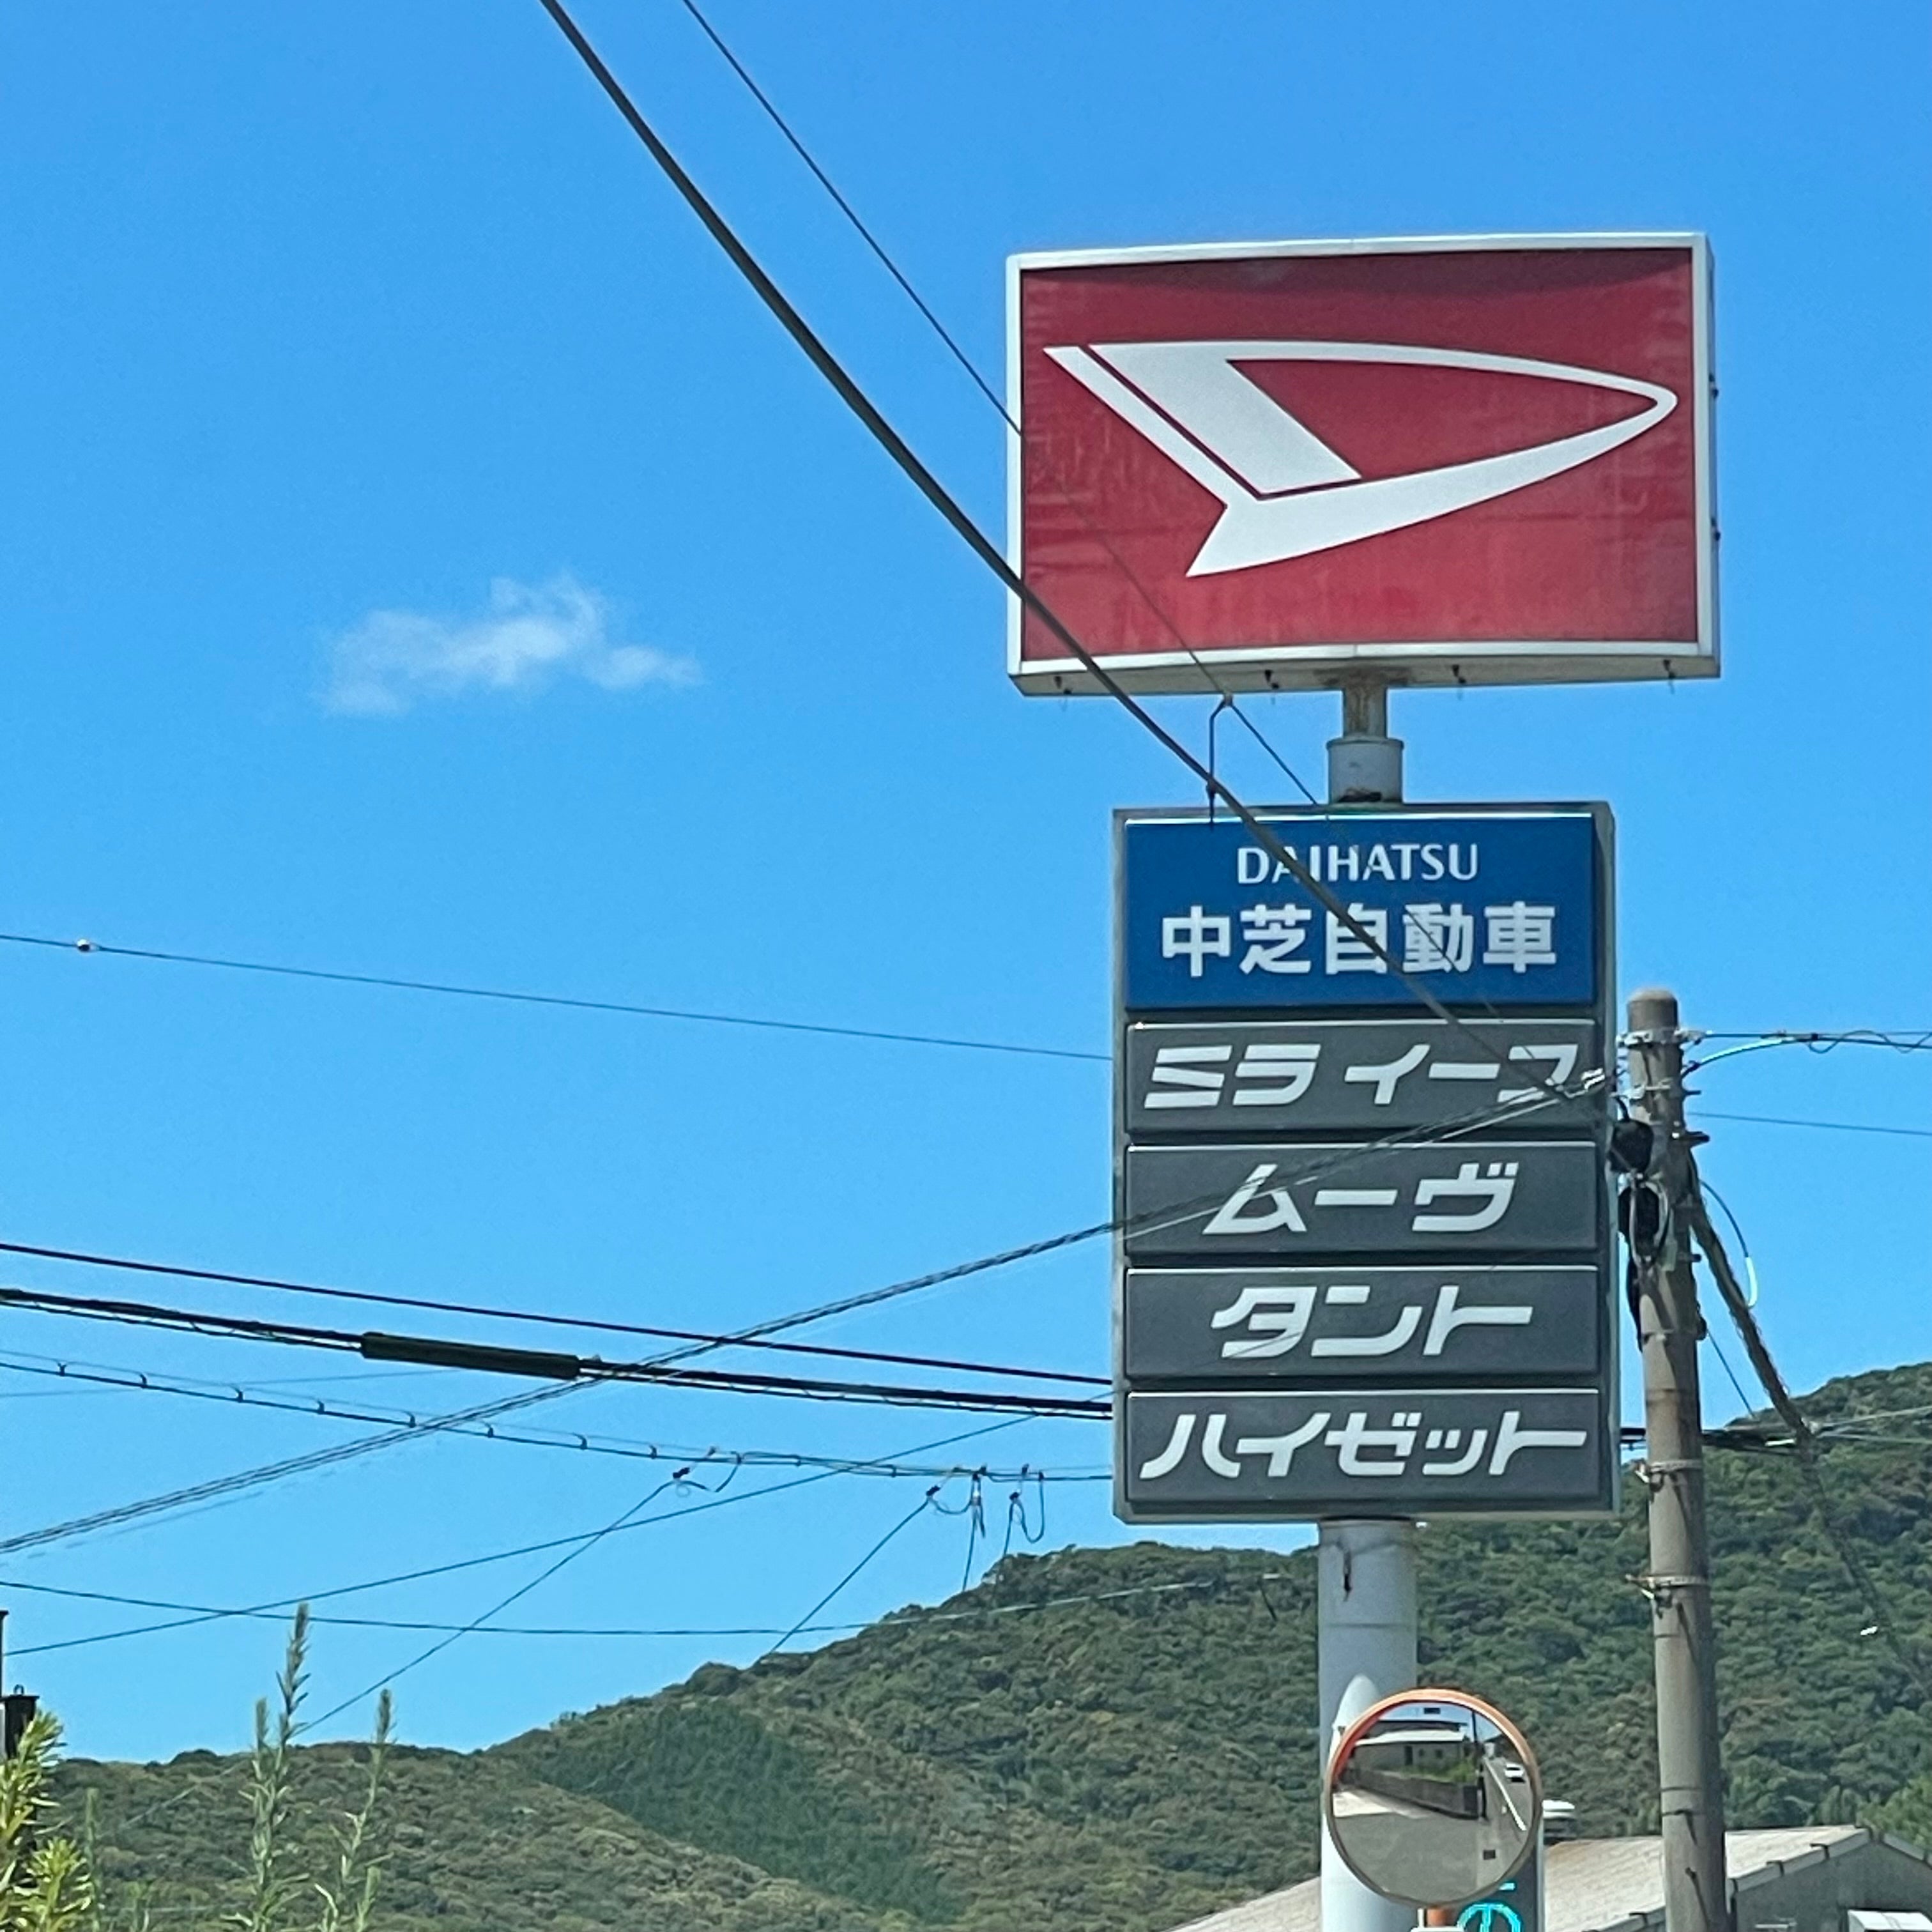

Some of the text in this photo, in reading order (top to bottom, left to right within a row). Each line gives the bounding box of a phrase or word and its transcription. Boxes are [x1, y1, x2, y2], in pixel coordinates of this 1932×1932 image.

[1237, 843, 1478, 884] DAIHATSU
[1162, 901, 1556, 977] 中芝自動車
[1144, 1044, 1321, 1108] ミラ
[1202, 1162, 1519, 1235] ムーヴ
[1211, 1285, 1533, 1358] タント
[1139, 1411, 1587, 1479] ハイゼット
